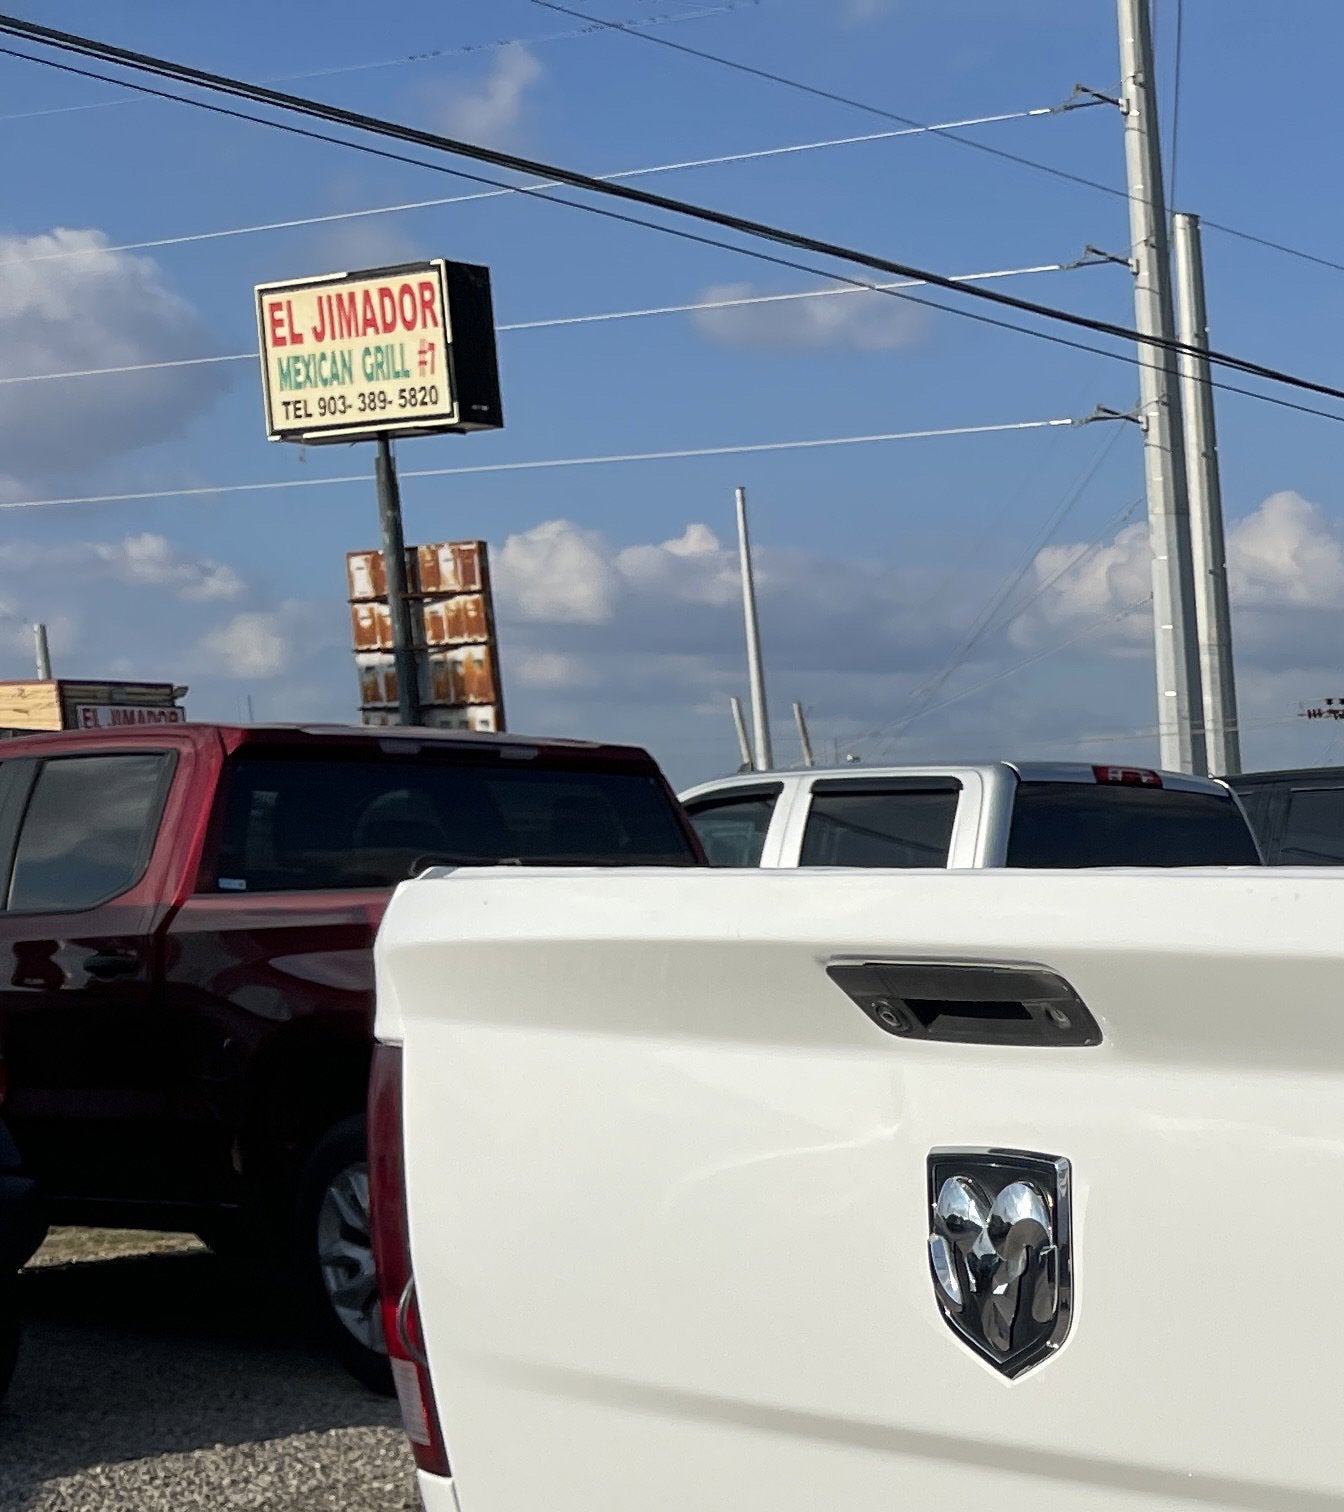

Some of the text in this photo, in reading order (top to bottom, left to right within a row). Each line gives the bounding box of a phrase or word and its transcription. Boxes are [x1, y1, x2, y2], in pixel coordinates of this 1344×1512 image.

[268, 281, 440, 348] EL JIMADOR
[276, 348, 354, 392] MEXICAN
[361, 342, 411, 383] GRILL
[281, 398, 313, 420] TEL
